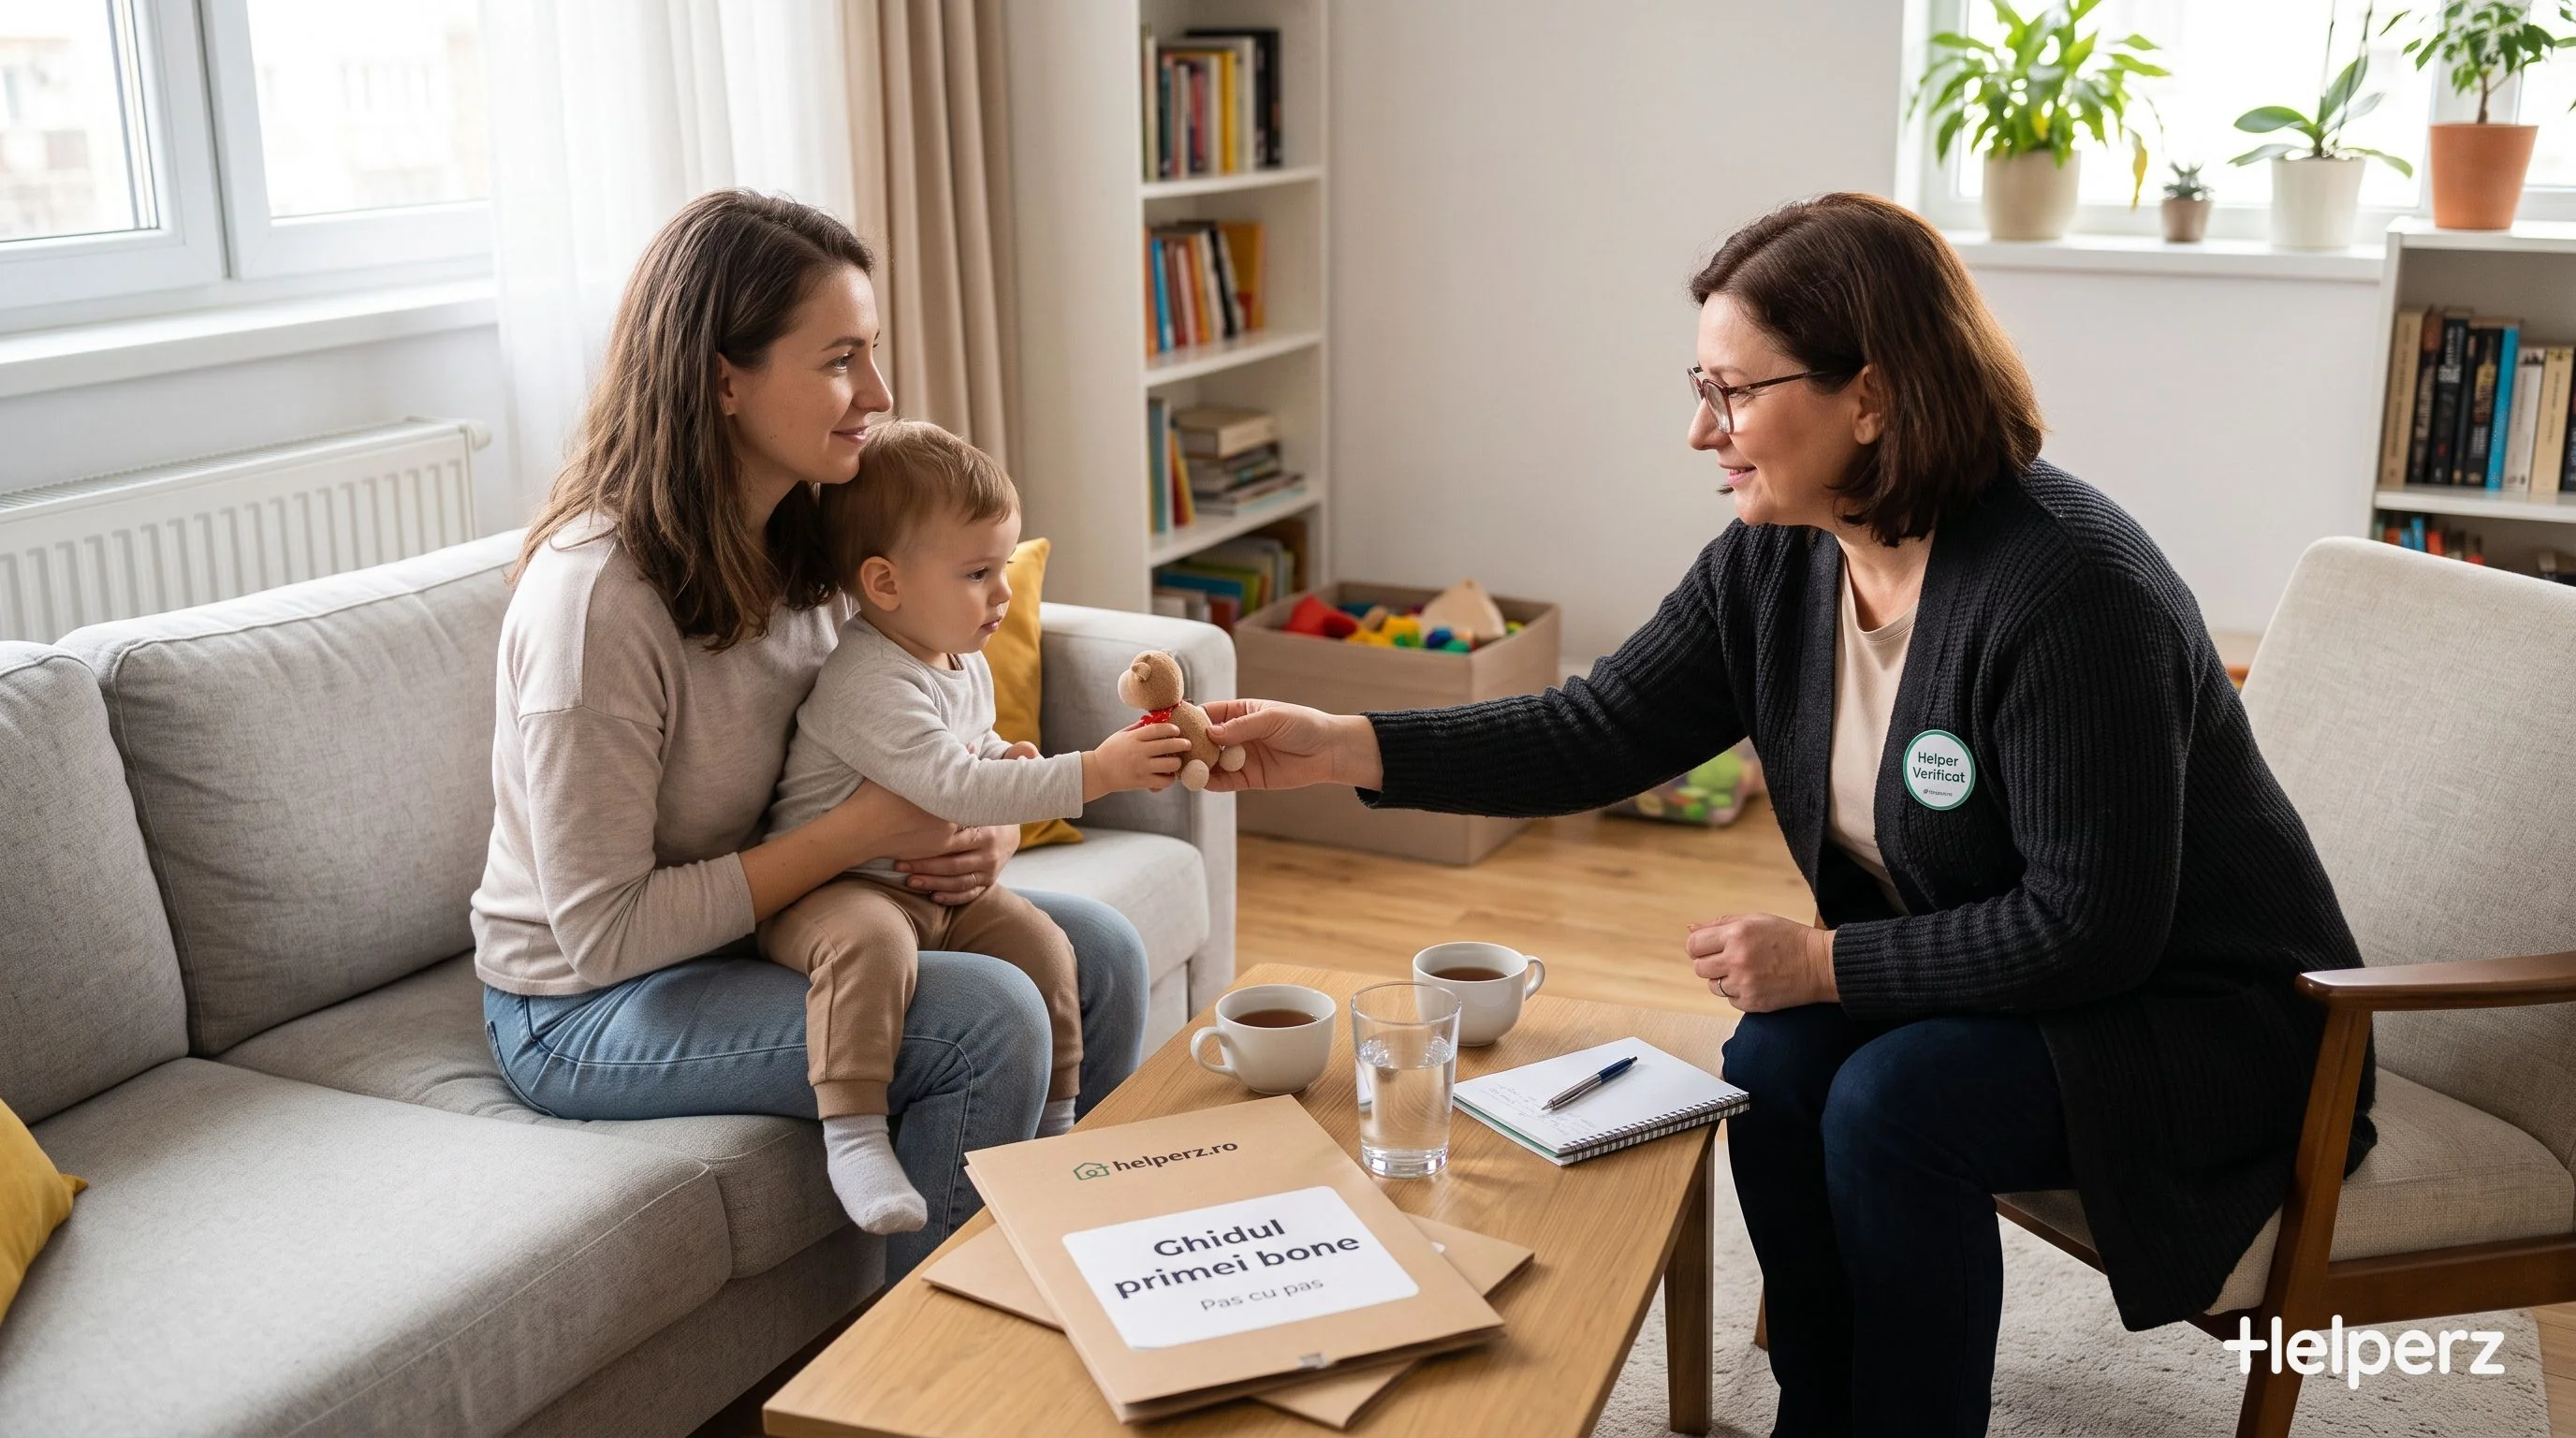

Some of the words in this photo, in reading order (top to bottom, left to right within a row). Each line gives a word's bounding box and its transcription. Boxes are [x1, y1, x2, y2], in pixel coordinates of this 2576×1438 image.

[1912, 767, 1966, 783] Verificat
[1918, 752, 1959, 767] Helper
[1112, 1140, 1238, 1172] helperz.ro
[1153, 1219, 1285, 1256] Ghidul
[1115, 1254, 1249, 1299] primei
[1257, 1235, 1360, 1268] bone
[1200, 1294, 1244, 1311] Pas
[1249, 1288, 1277, 1302] cu
[1282, 1278, 1325, 1298] pas
